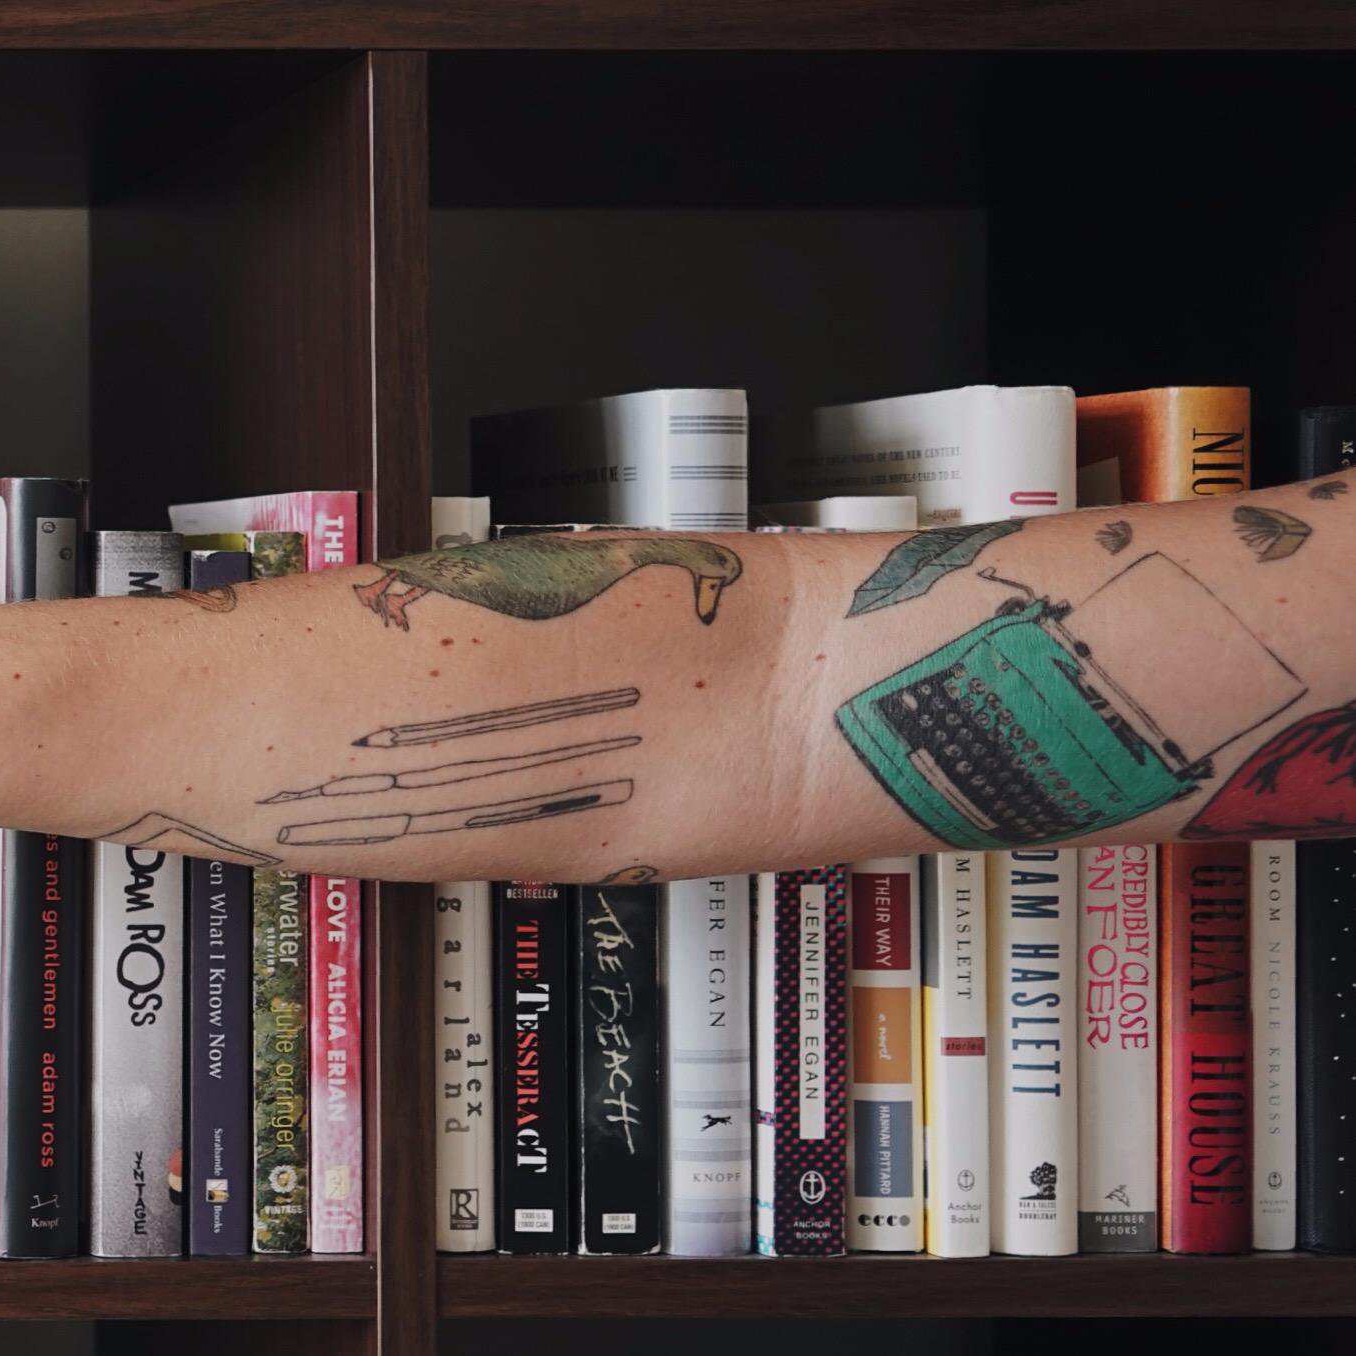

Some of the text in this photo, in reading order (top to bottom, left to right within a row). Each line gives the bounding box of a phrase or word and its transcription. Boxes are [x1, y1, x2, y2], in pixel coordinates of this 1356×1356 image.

[324, 515, 344, 563] THE
[45, 860, 62, 900] and
[327, 879, 347, 943] LOVE
[506, 889, 559, 899] BESTSELLER
[874, 877, 891, 967] THEIR WAY
[1267, 855, 1282, 922] ROOM
[41, 909, 58, 1029] gentlemen
[117, 923, 166, 1027] ROSS
[515, 919, 539, 981] THE
[956, 889, 972, 999] HASLETT
[1085, 903, 1119, 1049] FOER
[1189, 863, 1246, 1017] GREAT
[208, 893, 229, 1080] What Know Now
[436, 896, 470, 1134] garland
[708, 950, 726, 1028] EGAN
[804, 902, 819, 1100] JENNIFER EGAN
[1011, 944, 1060, 1097] HASLETT
[1119, 961, 1151, 1050] CLOSE
[328, 963, 347, 1122] ALICIA ERIAN
[466, 1032, 488, 1117] alex
[515, 983, 550, 1174] TESSERACT
[1268, 942, 1282, 1136] NICOLE KRAUSS
[41, 1052, 59, 1168] adam ross
[880, 1105, 891, 1195] HANNAH PITTARD
[1188, 1051, 1246, 1206] HOUSE
[213, 1128, 224, 1234] Sarabande Books
[692, 1172, 742, 1183] KNOPF
[947, 1202, 983, 1212] Anchor
[950, 1214, 980, 1225] Books
[1095, 1215, 1146, 1224] MARINER
[30, 1217, 59, 1229] Knopf
[793, 1220, 831, 1228] ANCHOR
[796, 1231, 828, 1239] BOOKS
[1101, 1226, 1138, 1235] BOOKS
